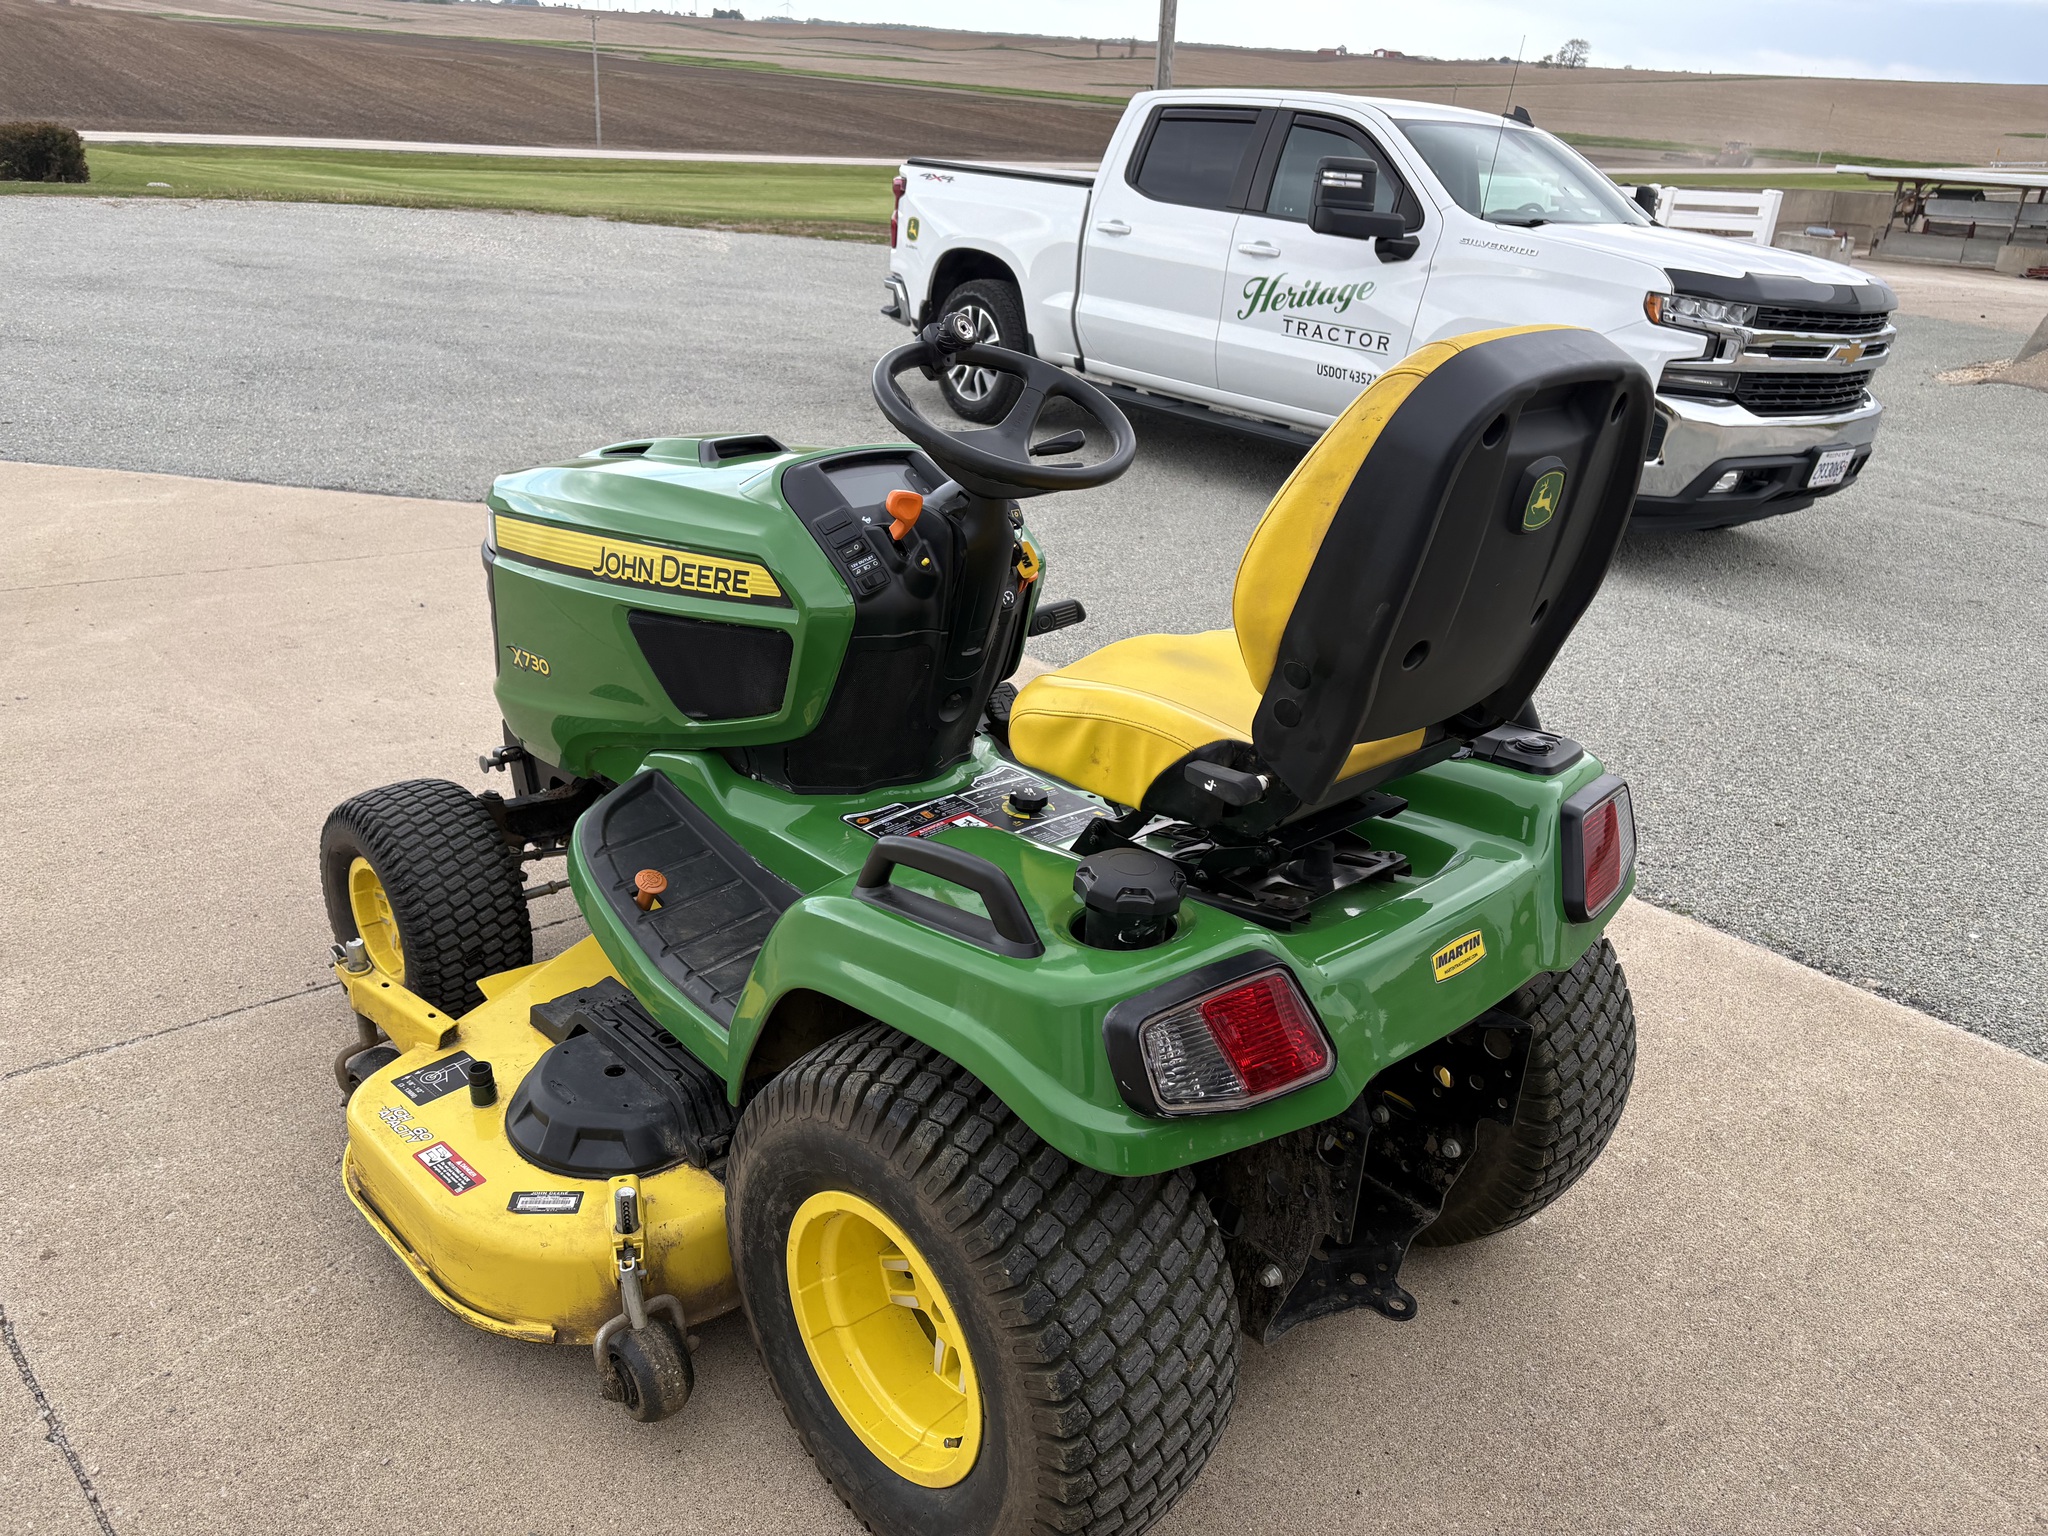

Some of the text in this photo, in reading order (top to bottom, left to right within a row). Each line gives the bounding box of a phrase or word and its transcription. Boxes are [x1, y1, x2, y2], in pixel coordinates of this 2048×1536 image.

[1237, 272, 1377, 320] Heritage
[1283, 318, 1390, 351] TRACTOR
[1316, 363, 1347, 381] USDOT
[593, 546, 750, 594] JOHN DEERE
[506, 646, 550, 676] X730
[1437, 933, 1481, 969] MARTIN
